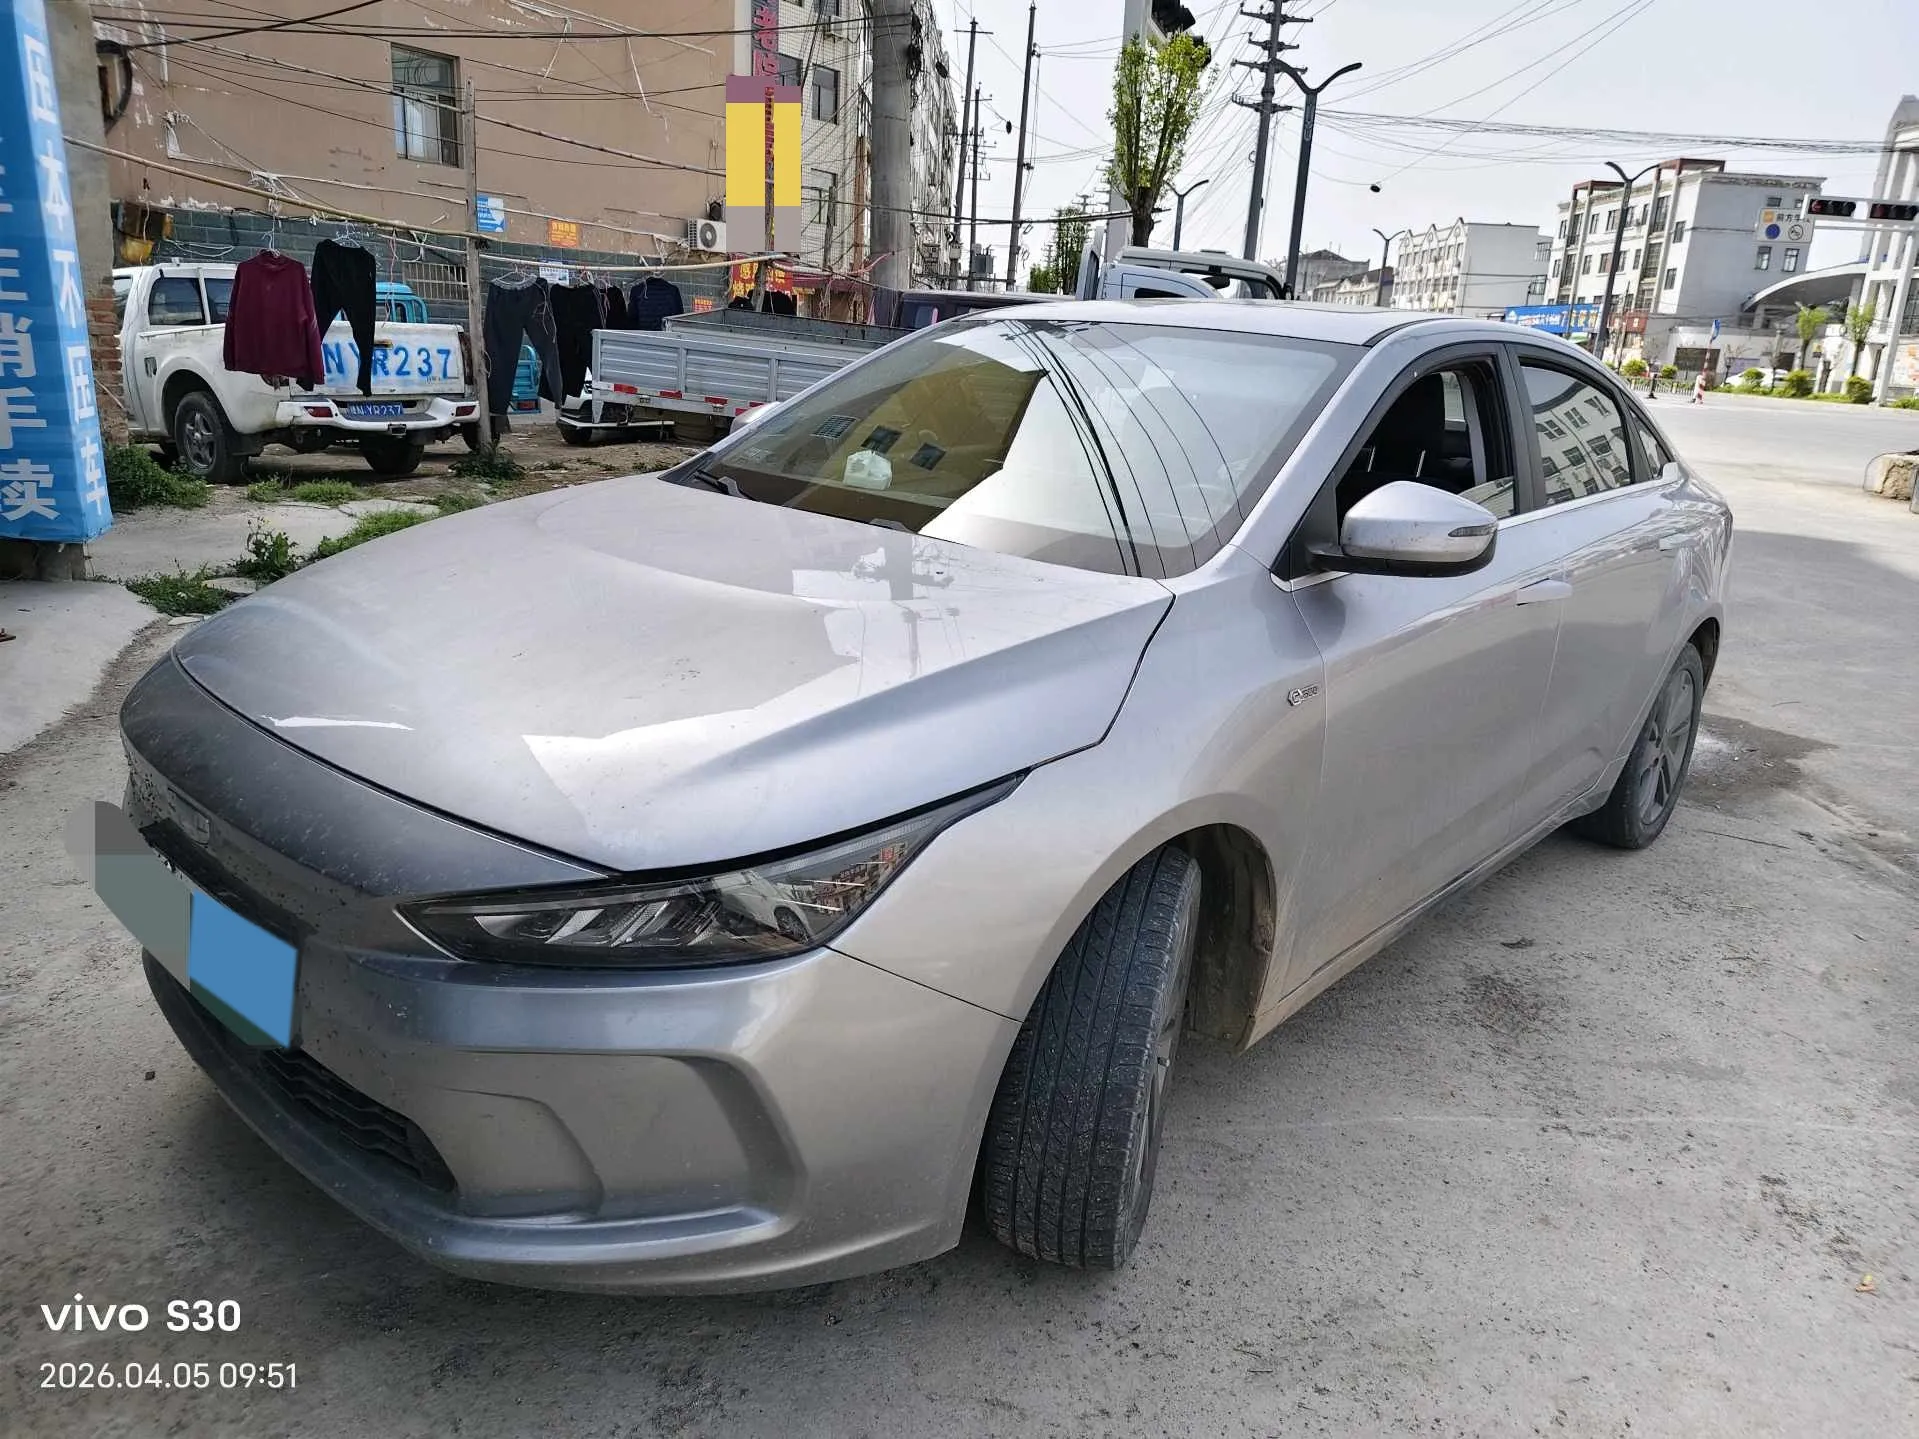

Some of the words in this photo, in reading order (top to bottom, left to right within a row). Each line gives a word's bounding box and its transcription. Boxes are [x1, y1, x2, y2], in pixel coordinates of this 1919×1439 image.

[24, 33, 107, 517] 压本不压车
